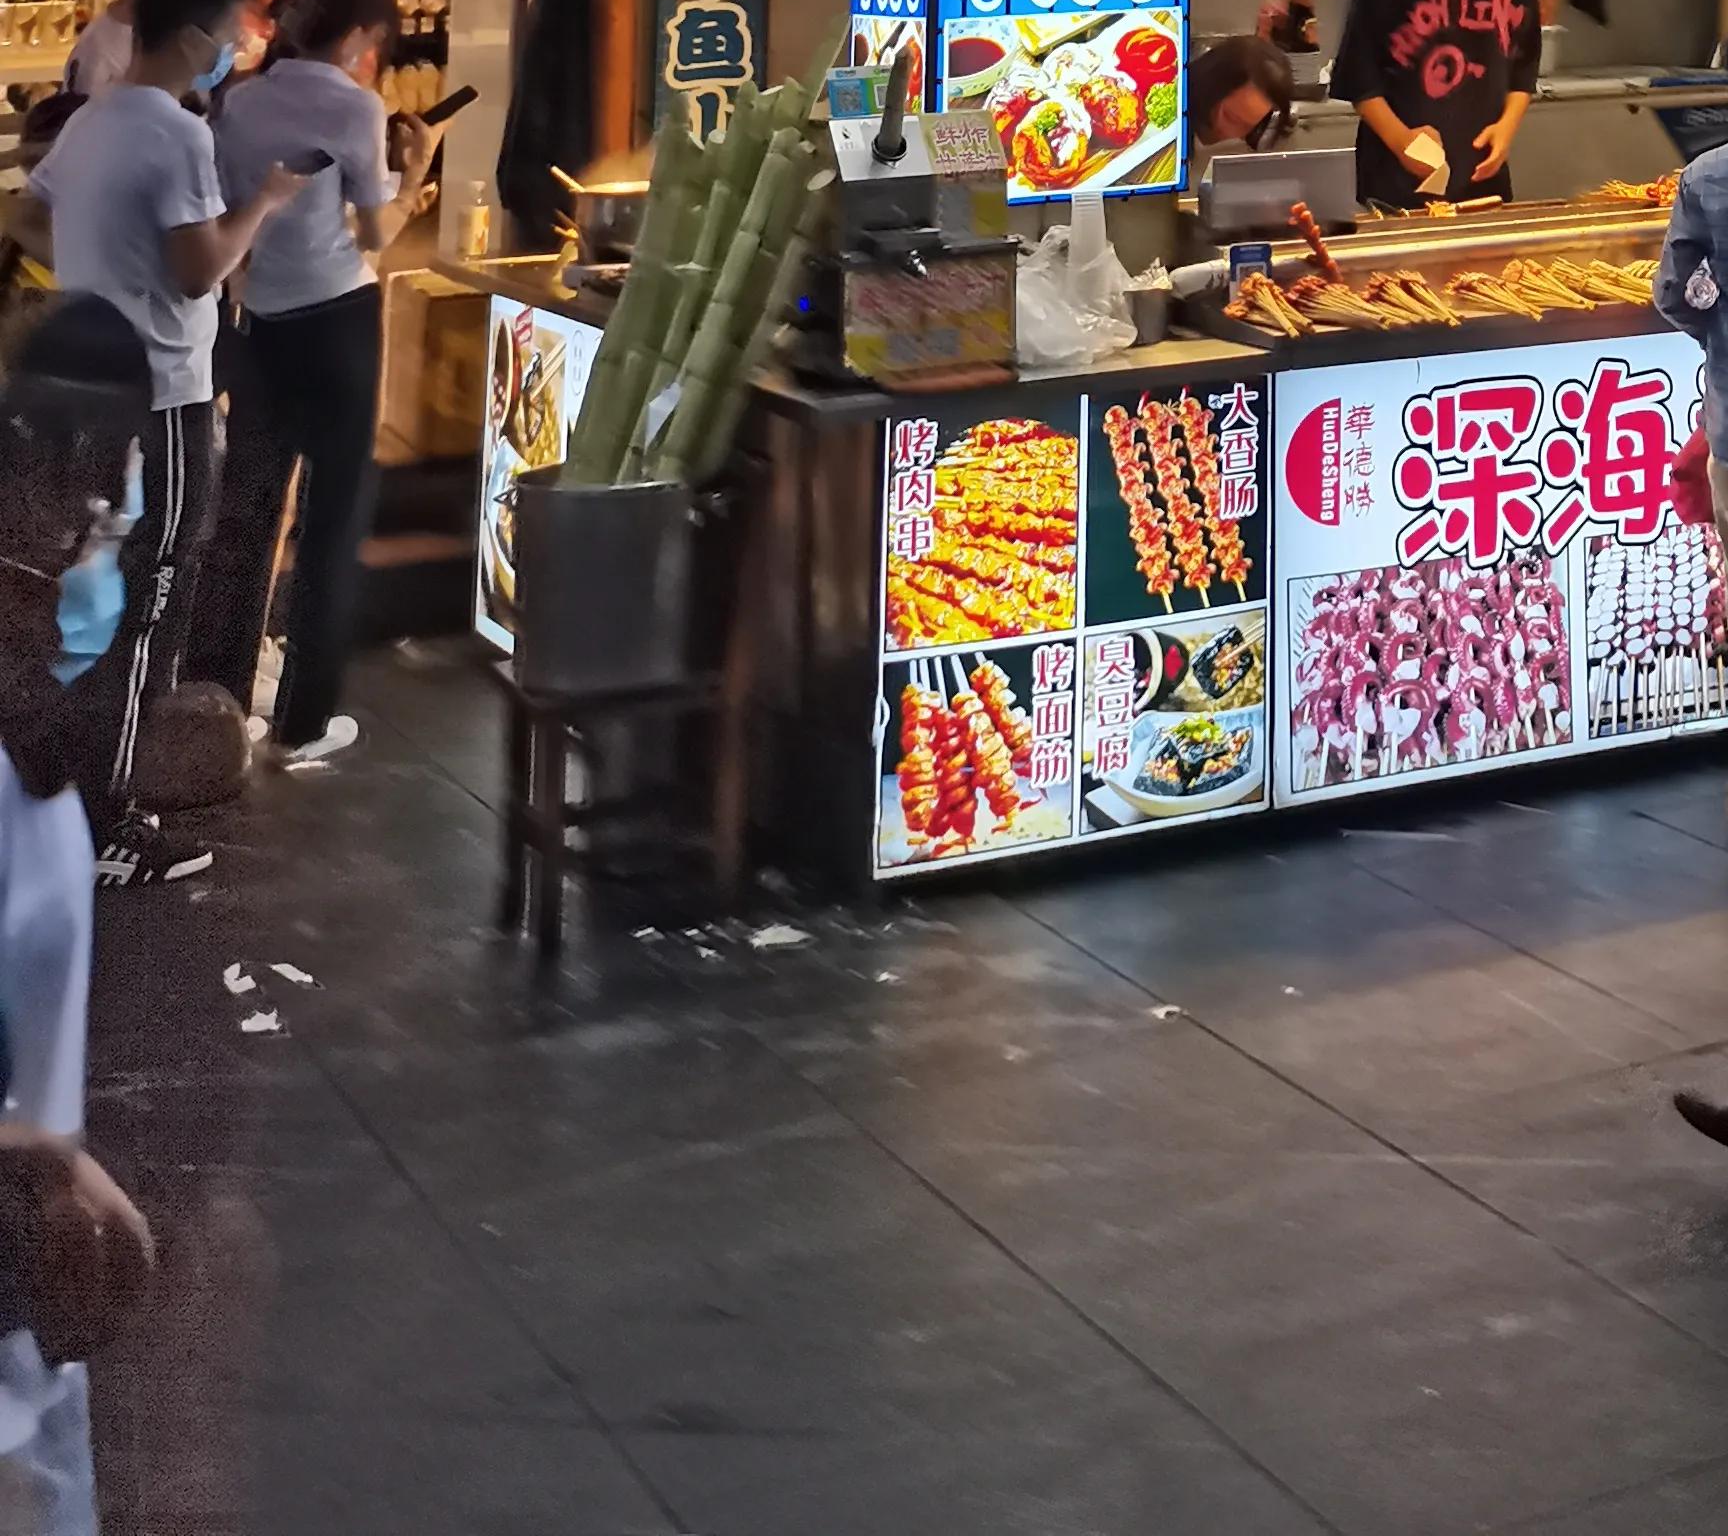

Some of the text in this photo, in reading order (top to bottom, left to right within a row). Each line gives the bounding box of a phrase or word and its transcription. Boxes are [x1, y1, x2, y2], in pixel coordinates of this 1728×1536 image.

[894, 416, 939, 562] 烤肉串
[1218, 382, 1260, 520] 大香肠
[1320, 406, 1341, 522] HuaDeSheng
[1393, 357, 1706, 568] 深海
[1031, 642, 1075, 790] 烤面筋
[1093, 633, 1135, 778] 臭豆腐
